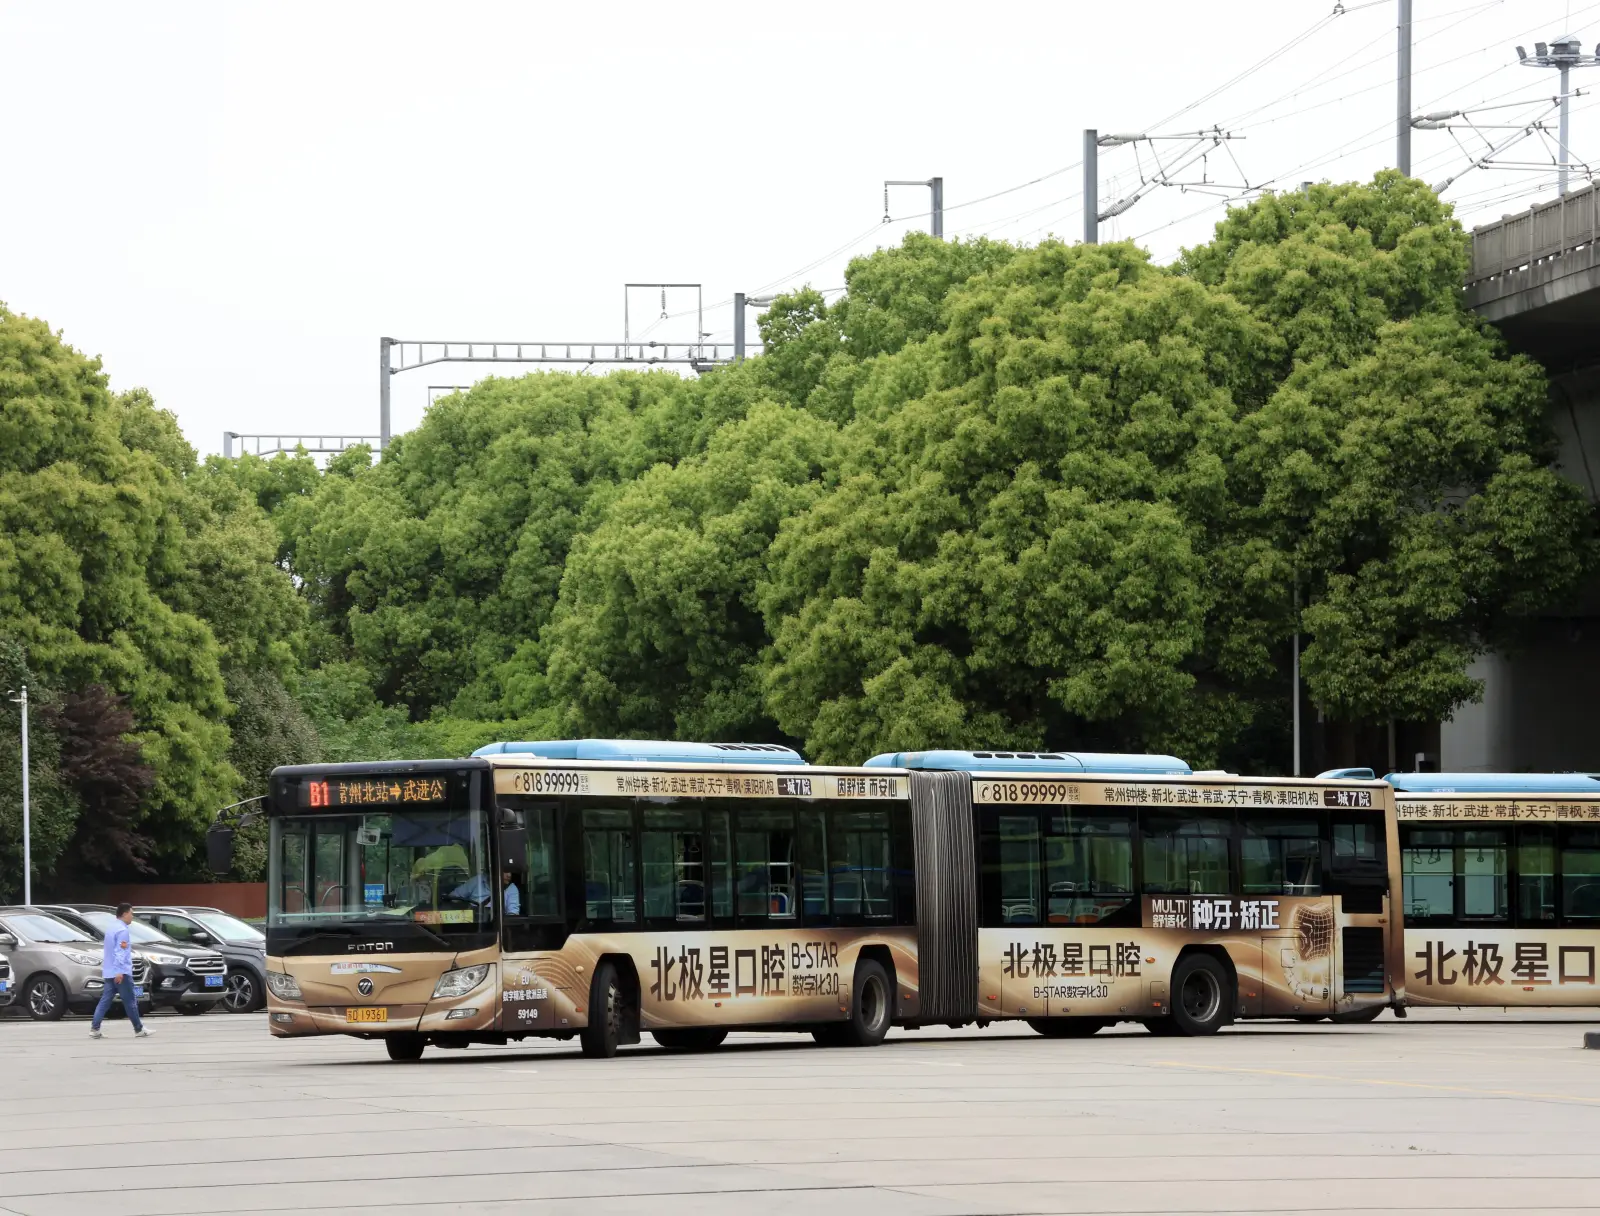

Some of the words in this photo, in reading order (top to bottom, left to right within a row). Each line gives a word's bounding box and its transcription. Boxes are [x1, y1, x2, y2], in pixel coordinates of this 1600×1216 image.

[310, 781, 329, 806] B1
[403, 779, 447, 801] 武进公
[523, 772, 543, 792] 818
[544, 772, 579, 792] 99999
[837, 778, 866, 797] 因舒适
[869, 778, 898, 797] 而安心
[992, 783, 1018, 802] 818
[1020, 784, 1067, 802] 99999
[347, 941, 394, 951] FOTON
[791, 941, 839, 970] B-STAR
[1003, 941, 1142, 979] 北极星口腔
[1414, 940, 1596, 986] 北极星口
[650, 943, 786, 1002] 北极星口腔
[791, 972, 839, 997] 数字化3.0
[518, 1009, 538, 1019] 59149
